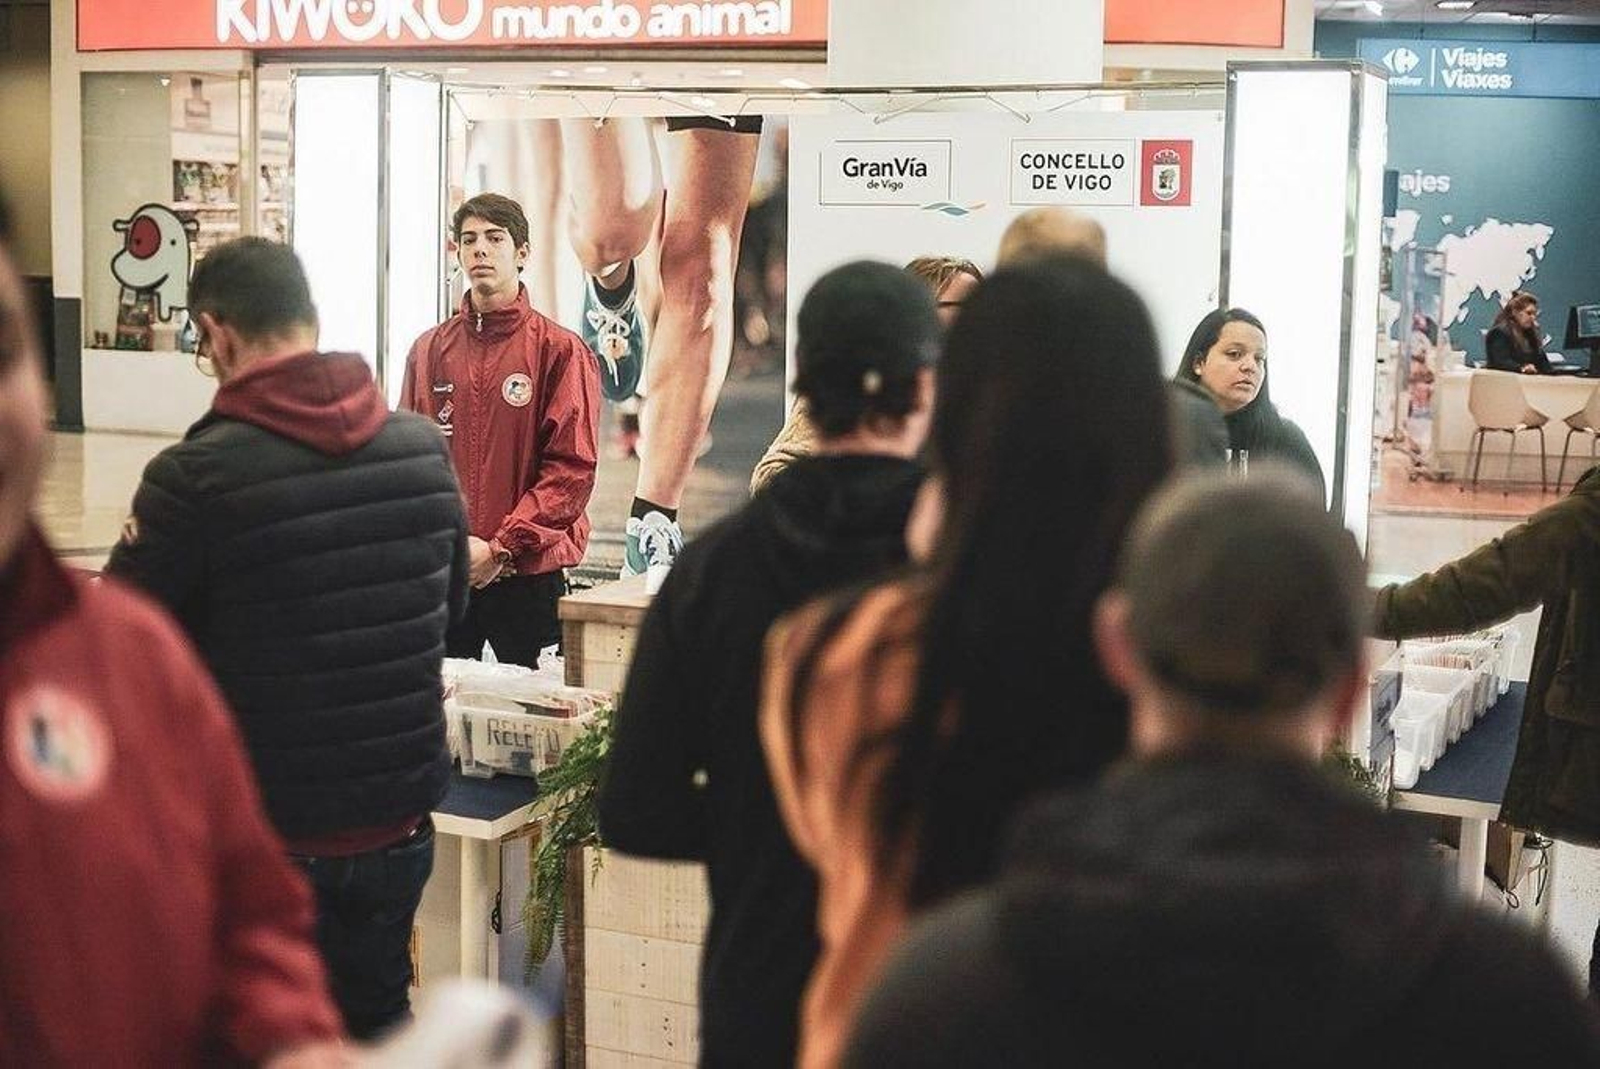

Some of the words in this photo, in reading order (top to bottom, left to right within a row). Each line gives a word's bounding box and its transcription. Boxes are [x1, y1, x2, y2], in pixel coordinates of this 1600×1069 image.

[491, 0, 641, 38] mundo
[647, 0, 793, 36] animal
[1442, 47, 1508, 72] Viajes
[1441, 69, 1513, 89] Viaxes
[842, 157, 928, 177] GranVía
[1020, 153, 1125, 170] CONCELLO
[867, 179, 880, 189] de
[881, 179, 904, 192] Vigo
[1033, 174, 1058, 190] DE
[1065, 174, 1112, 190] VIGO
